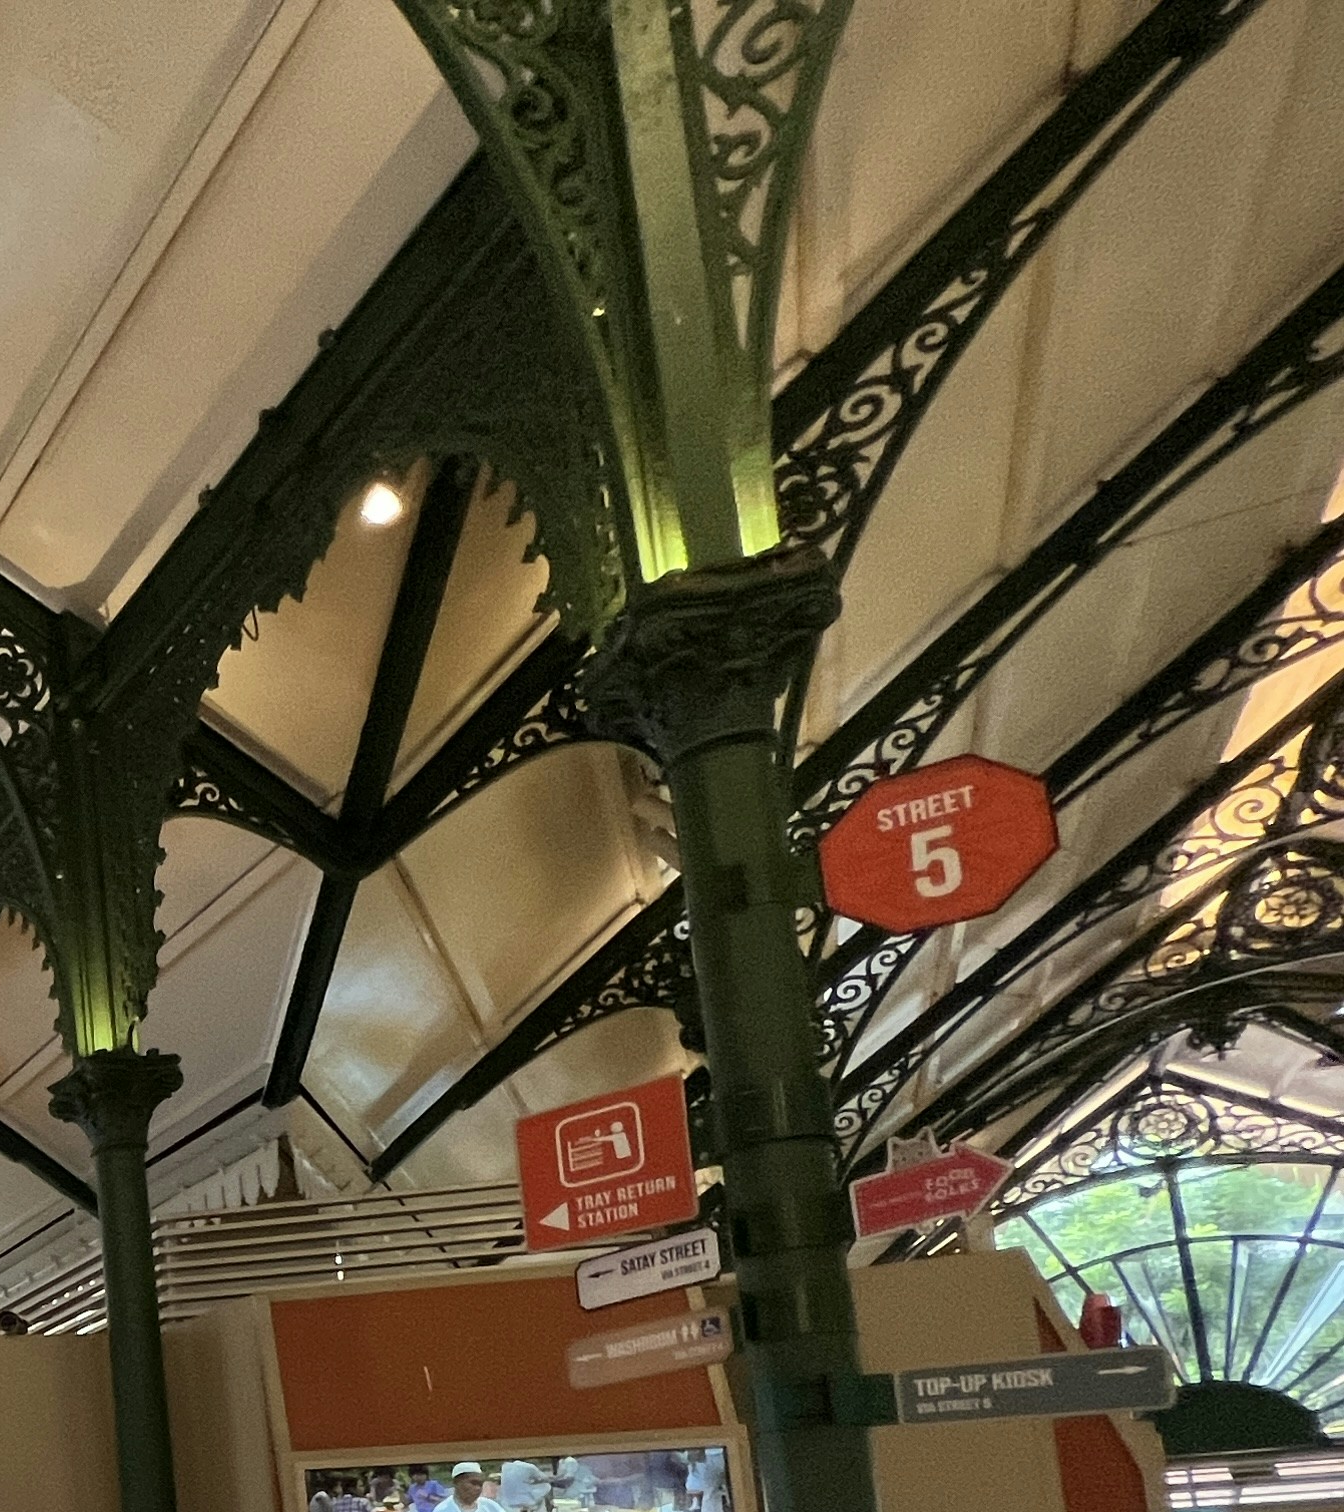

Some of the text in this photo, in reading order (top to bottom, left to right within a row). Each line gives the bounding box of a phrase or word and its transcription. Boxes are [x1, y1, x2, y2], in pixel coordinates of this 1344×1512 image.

[876, 785, 974, 833] STREET
[910, 824, 963, 898] 5
[576, 1176, 676, 1211] TRAY RETURN
[577, 1203, 639, 1229] STATION
[620, 1239, 708, 1276] SATAY STREET
[605, 1329, 678, 1359] WASHROOM
[913, 1368, 1054, 1397] TOP-UP KIOSK
